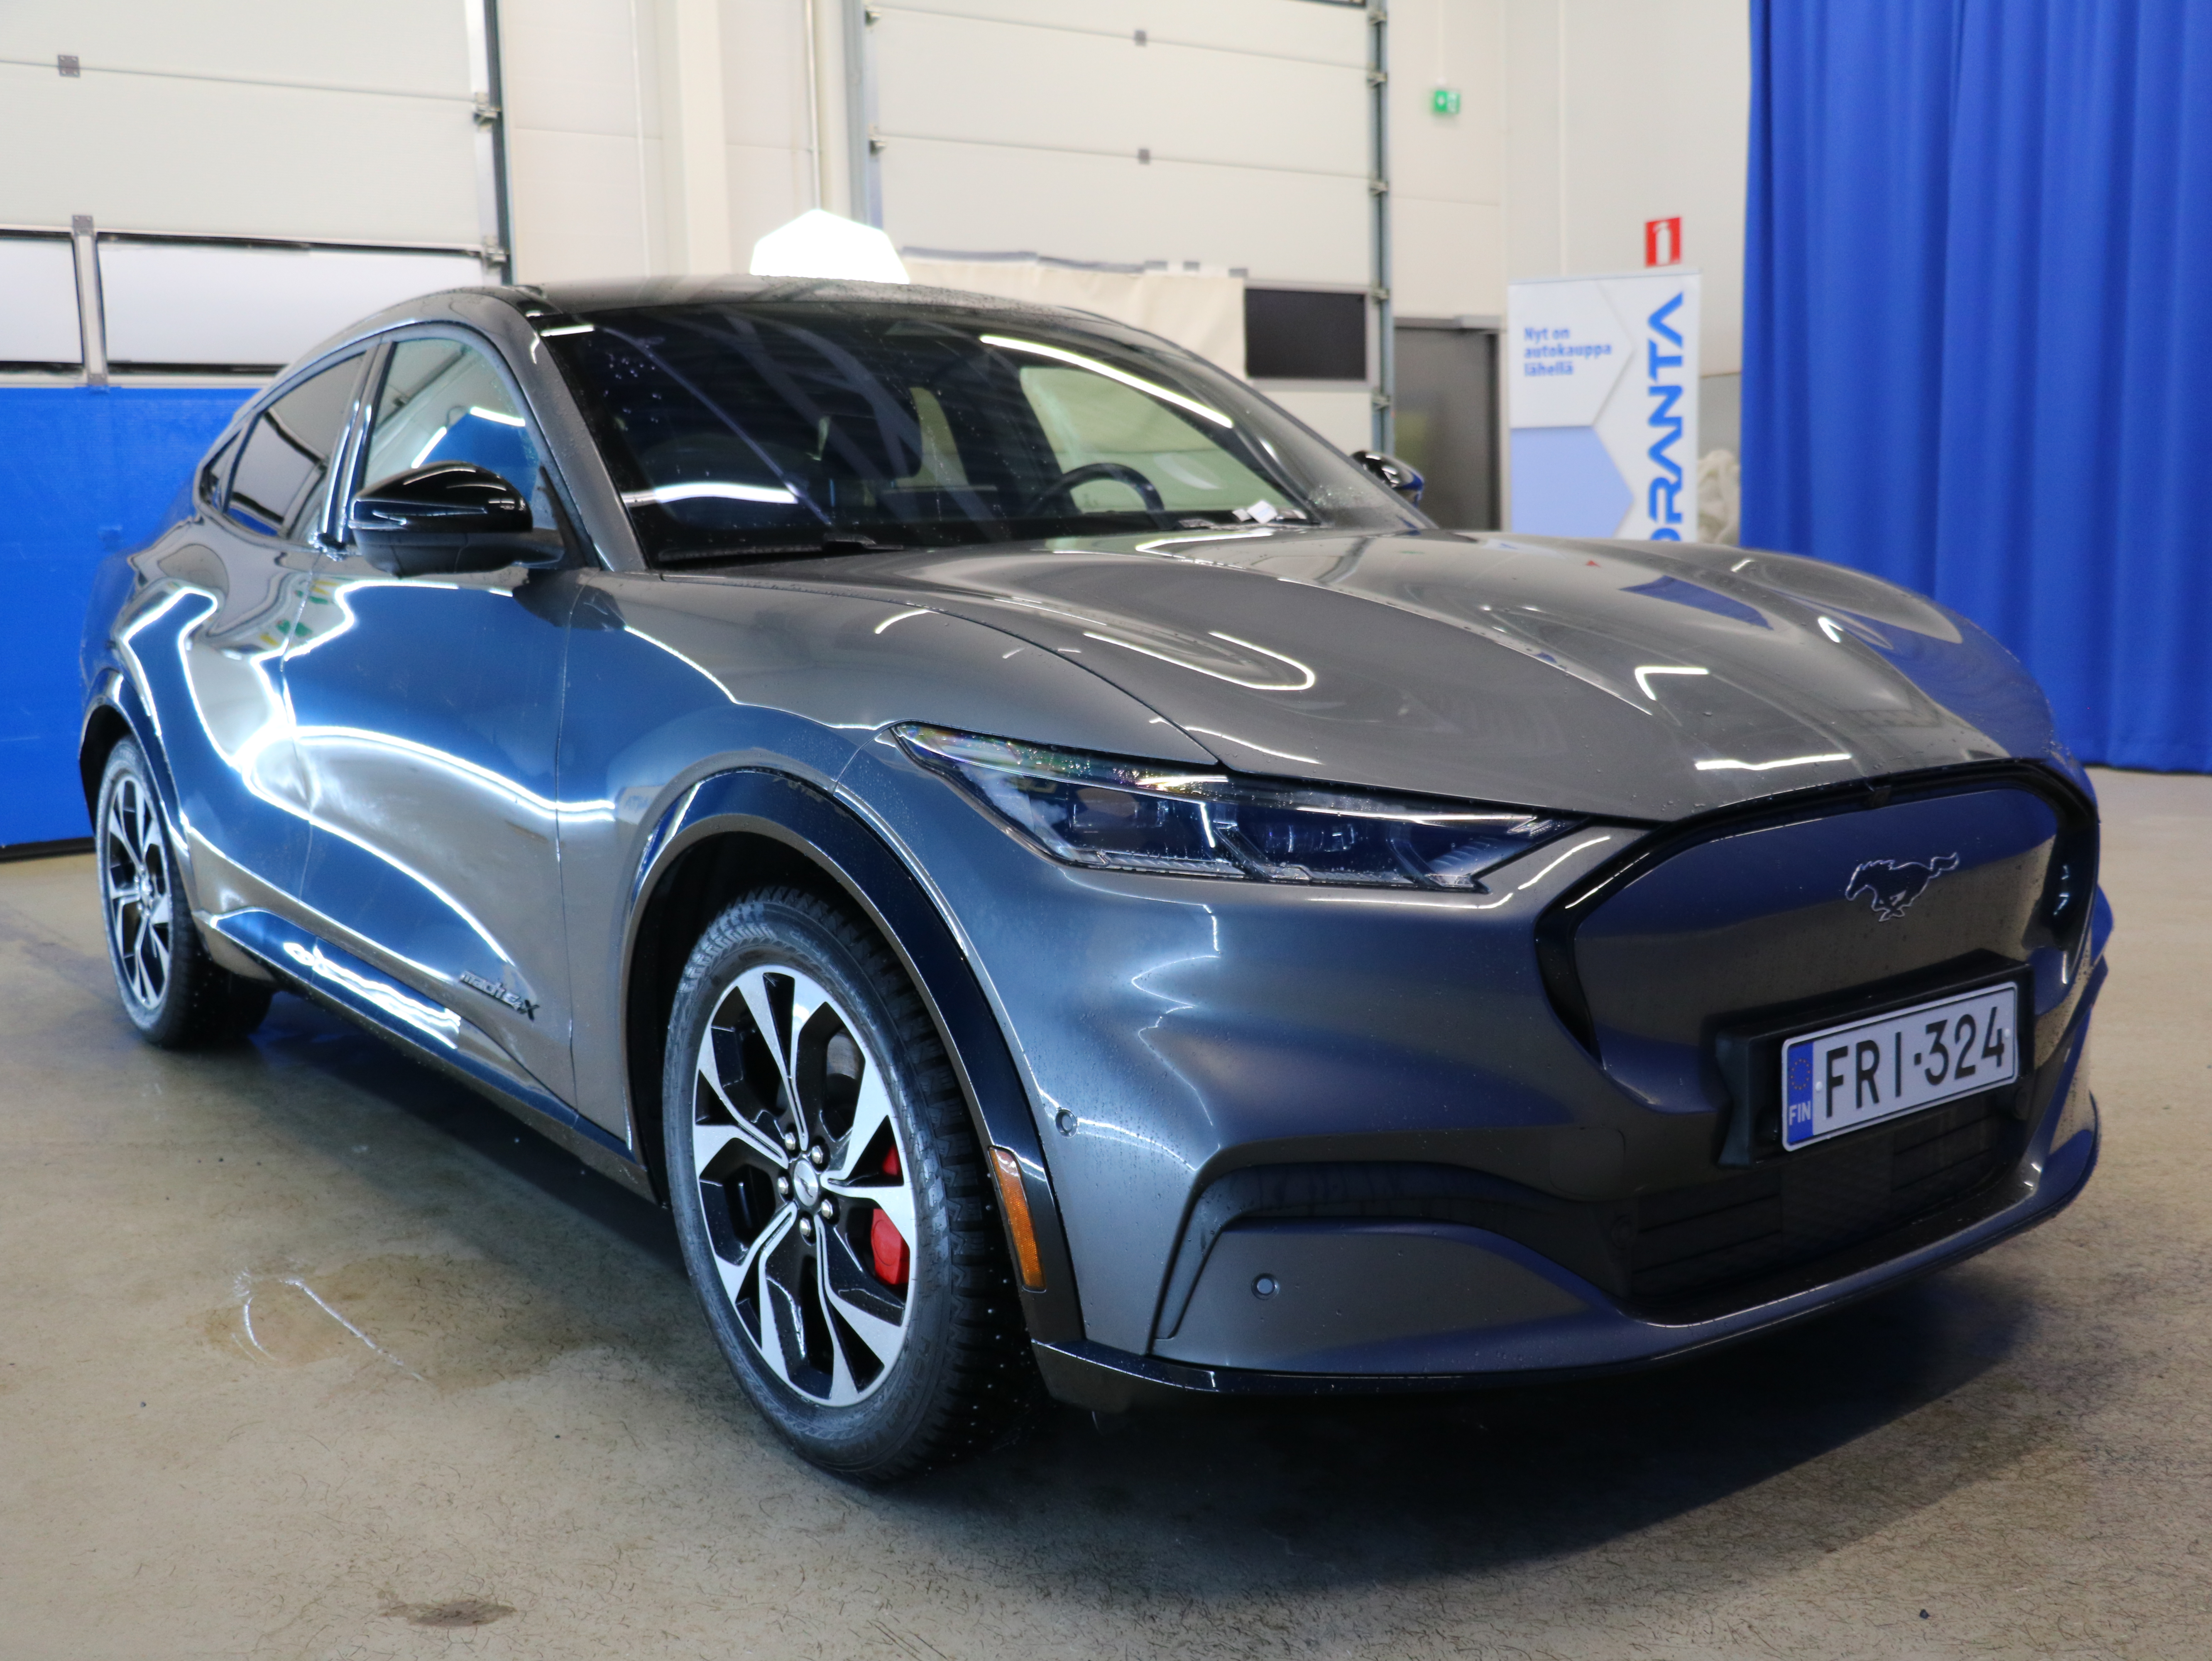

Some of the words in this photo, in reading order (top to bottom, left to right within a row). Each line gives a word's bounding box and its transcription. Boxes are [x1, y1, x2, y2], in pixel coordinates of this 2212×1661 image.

[1524, 327, 1548, 344] Nyt
[1553, 329, 1570, 340] on
[1524, 343, 1613, 360] autokauppa
[1524, 362, 1573, 377] lähellä
[1826, 1006, 2004, 1118] FRI-324
[1789, 1100, 1811, 1126] FIN
